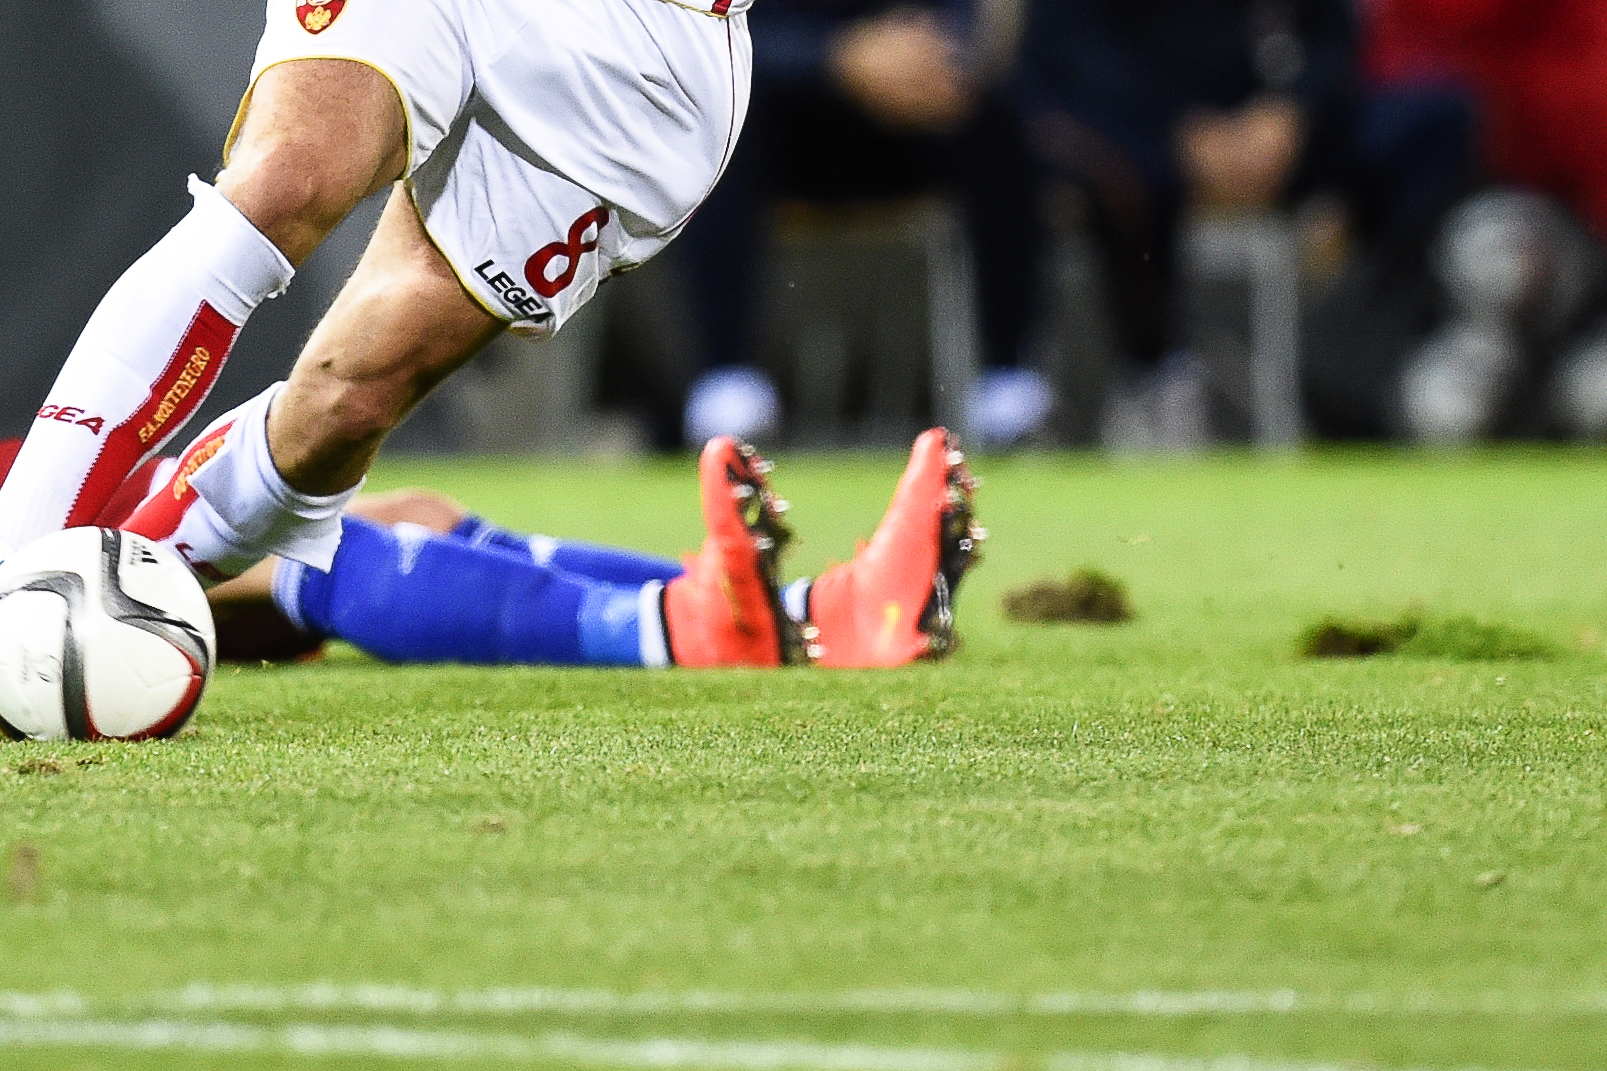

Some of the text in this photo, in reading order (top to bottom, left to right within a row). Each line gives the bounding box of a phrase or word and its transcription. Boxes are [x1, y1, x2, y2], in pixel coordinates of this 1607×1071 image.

[524, 205, 610, 299] 8
[474, 259, 554, 324] LEGEA
[37, 404, 106, 437] GEA
